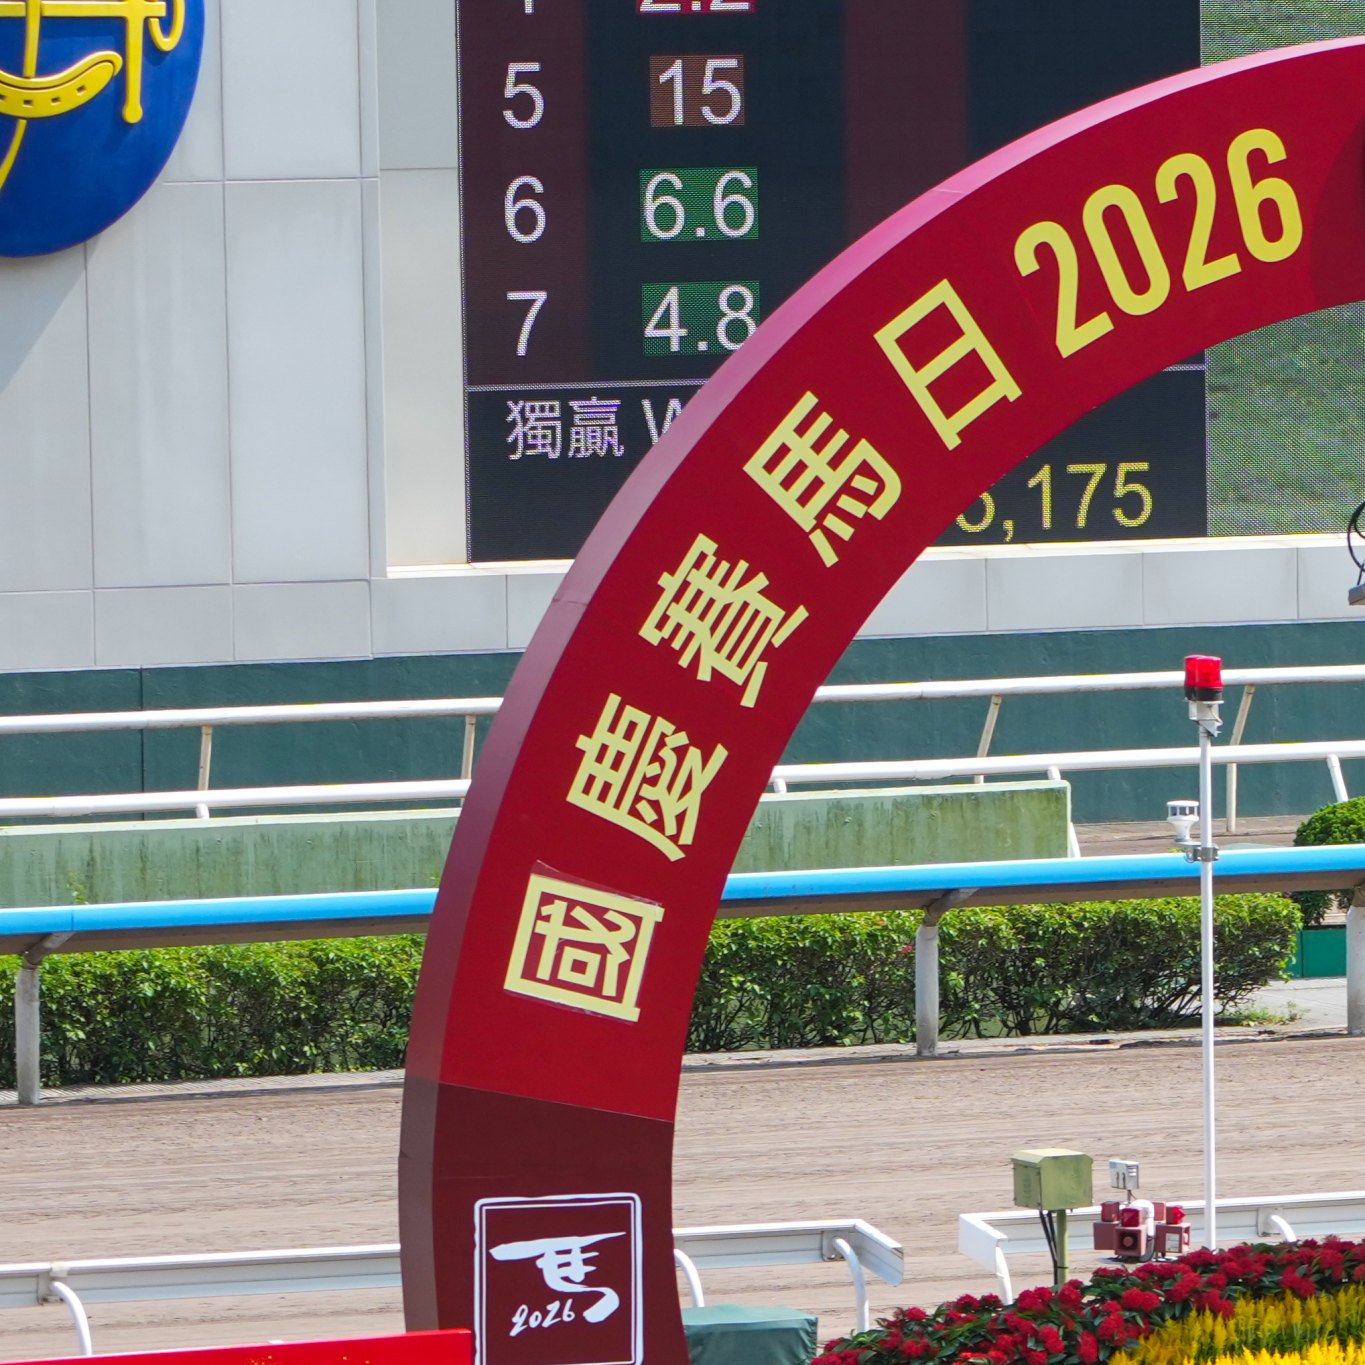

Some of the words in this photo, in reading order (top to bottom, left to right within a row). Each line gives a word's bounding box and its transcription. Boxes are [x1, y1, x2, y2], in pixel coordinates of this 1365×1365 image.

[503, 62, 545, 129] 5
[659, 58, 742, 126] 15
[503, 175, 547, 244] 6
[643, 170, 756, 240] 6.6
[506, 291, 548, 357] 7
[643, 284, 758, 353] 4.8
[506, 396, 624, 461] 獨贏
[503, 278, 1023, 1024] 國慶賽馬日
[1013, 128, 1303, 360] 2026
[509, 1298, 576, 1337] 2026
